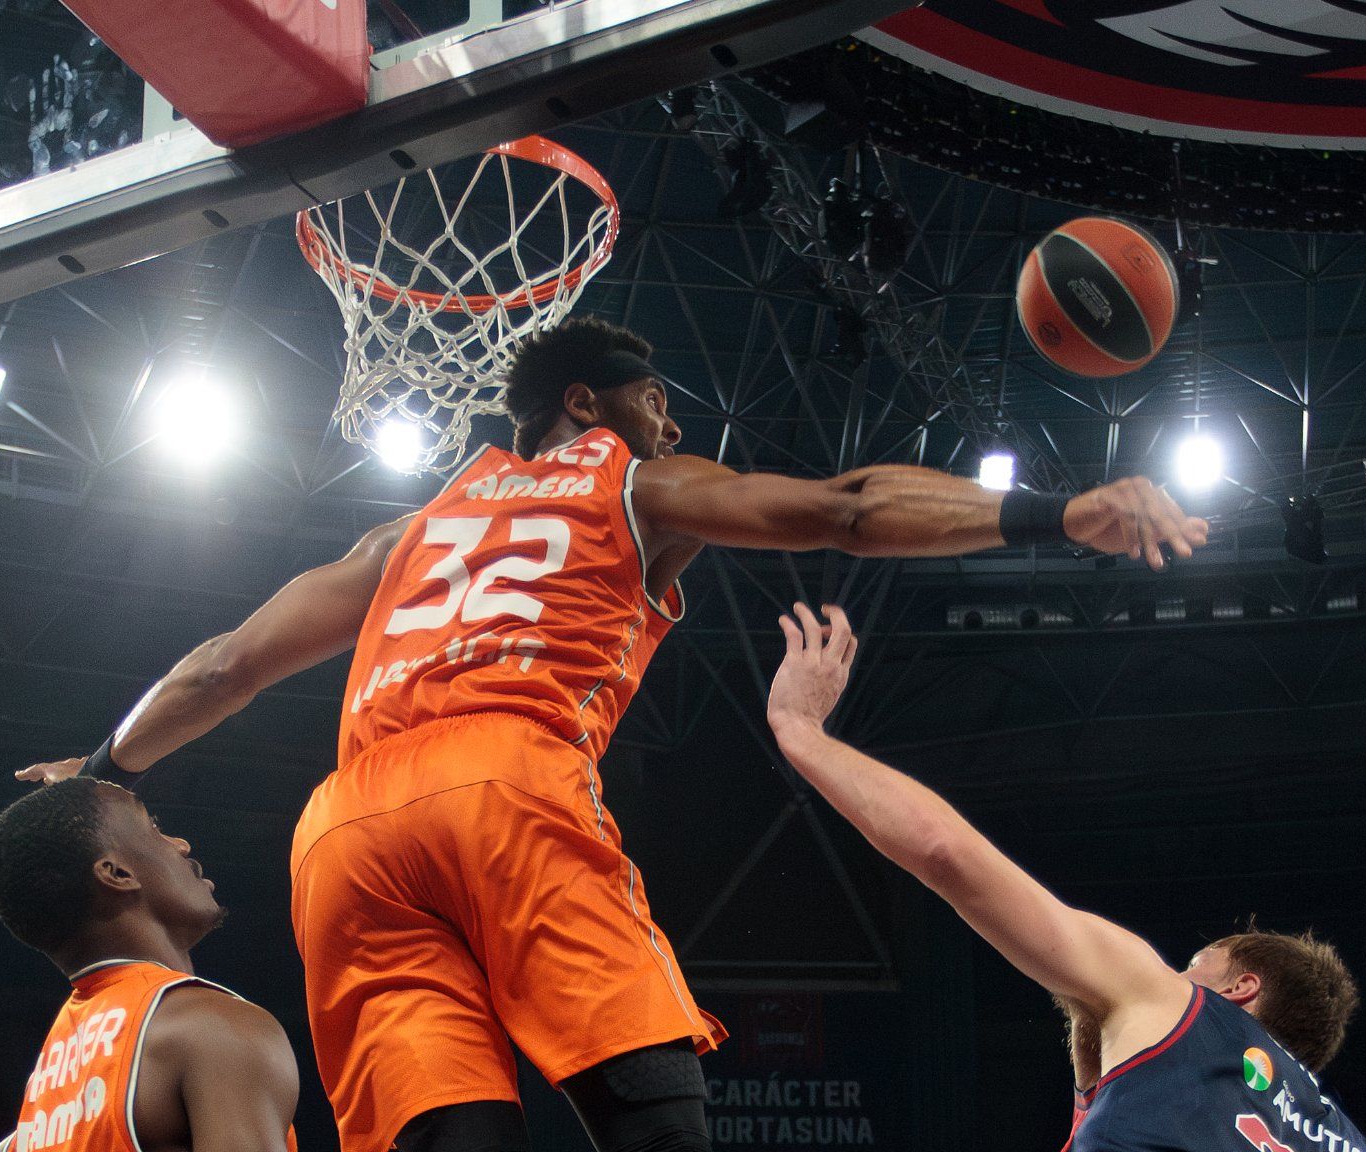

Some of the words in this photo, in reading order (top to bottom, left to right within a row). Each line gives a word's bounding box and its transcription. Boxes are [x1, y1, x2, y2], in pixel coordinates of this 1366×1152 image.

[461, 474, 595, 501] AMESA
[384, 517, 571, 635] 32
[706, 1071, 862, 1108] CARÁCTER
